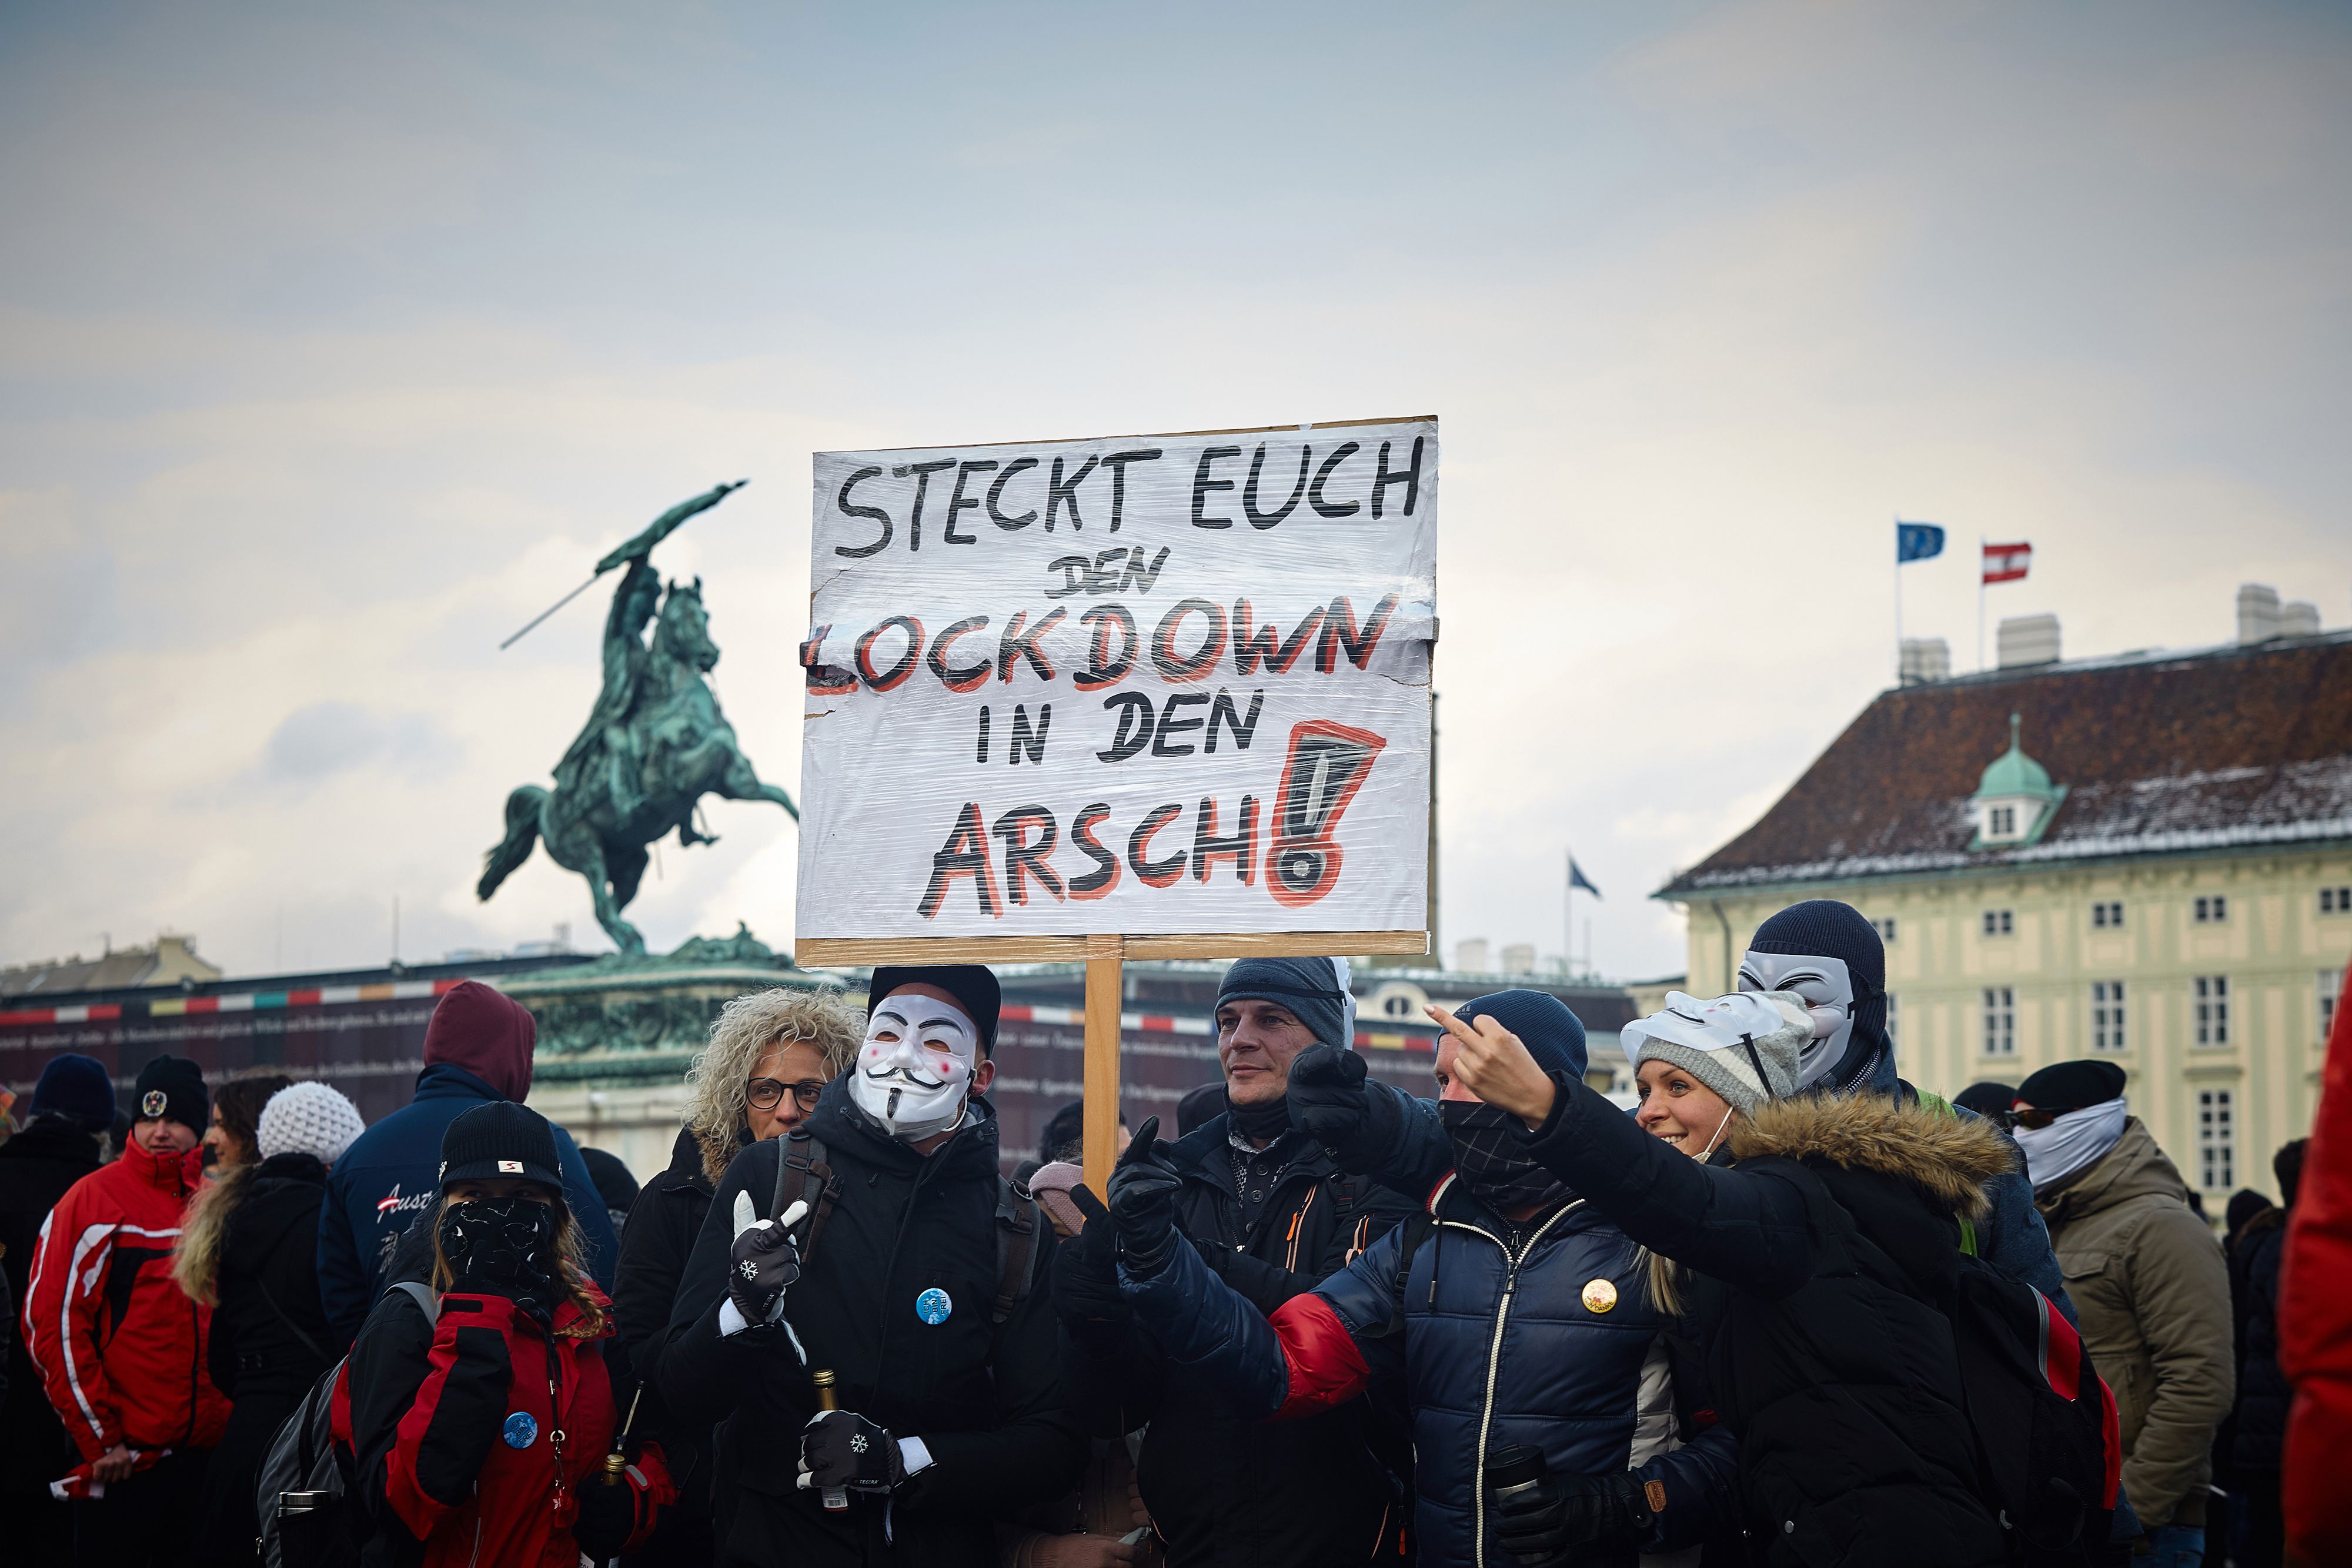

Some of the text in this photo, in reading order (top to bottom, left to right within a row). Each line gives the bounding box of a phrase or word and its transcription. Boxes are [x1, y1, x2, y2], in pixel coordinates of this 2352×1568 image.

[835, 435, 1424, 559] STECKT EUCH
[1044, 545, 1171, 600] DEN
[800, 592, 1400, 696] LOCKDOWN
[976, 687, 1264, 765] IN DEN
[510, 1417, 523, 1429] ICH
[515, 1424, 527, 1436] BIN
[519, 1430, 534, 1445] FREI
